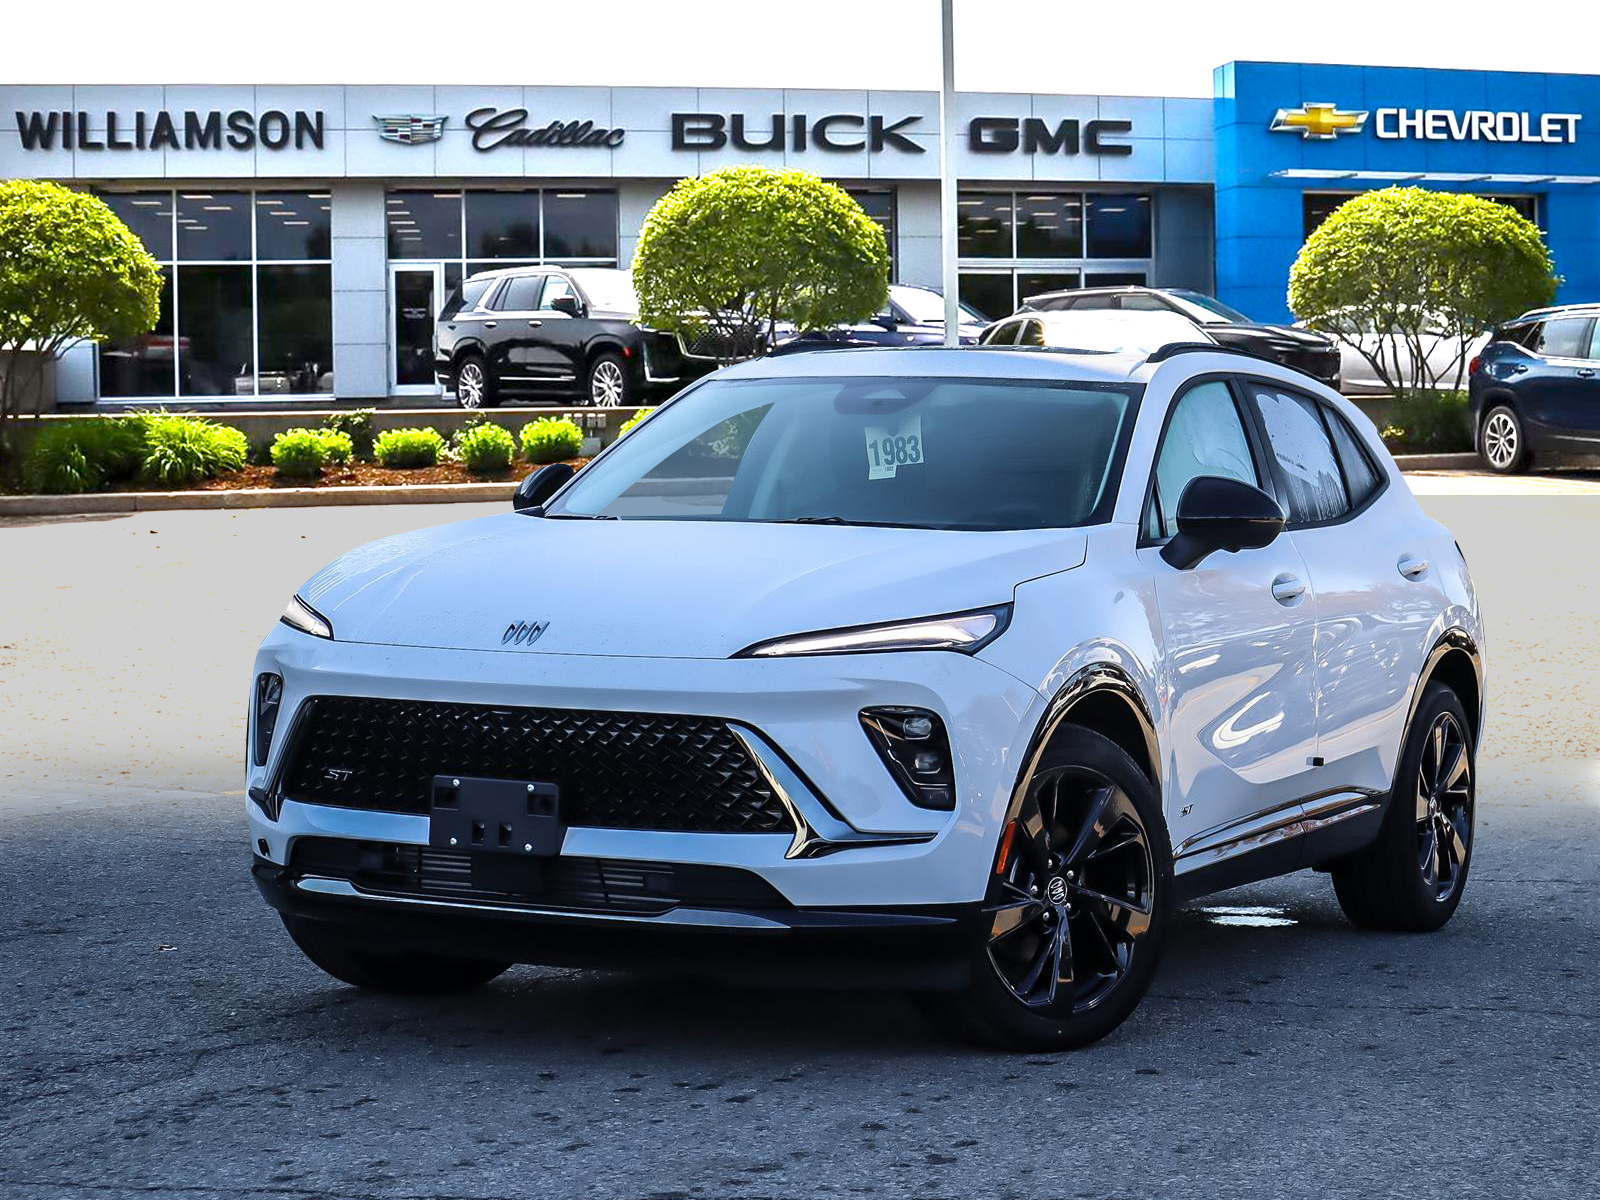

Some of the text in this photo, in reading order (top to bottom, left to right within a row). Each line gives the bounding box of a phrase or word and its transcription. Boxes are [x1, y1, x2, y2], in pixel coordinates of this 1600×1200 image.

[16, 110, 325, 151] WILLIAMSON
[465, 107, 625, 152] Cadillac
[671, 112, 926, 154] BUICK
[969, 116, 1133, 155] GMC
[1375, 108, 1582, 143] CHEVROLET
[869, 435, 921, 467] 1983
[324, 769, 353, 781] ST
